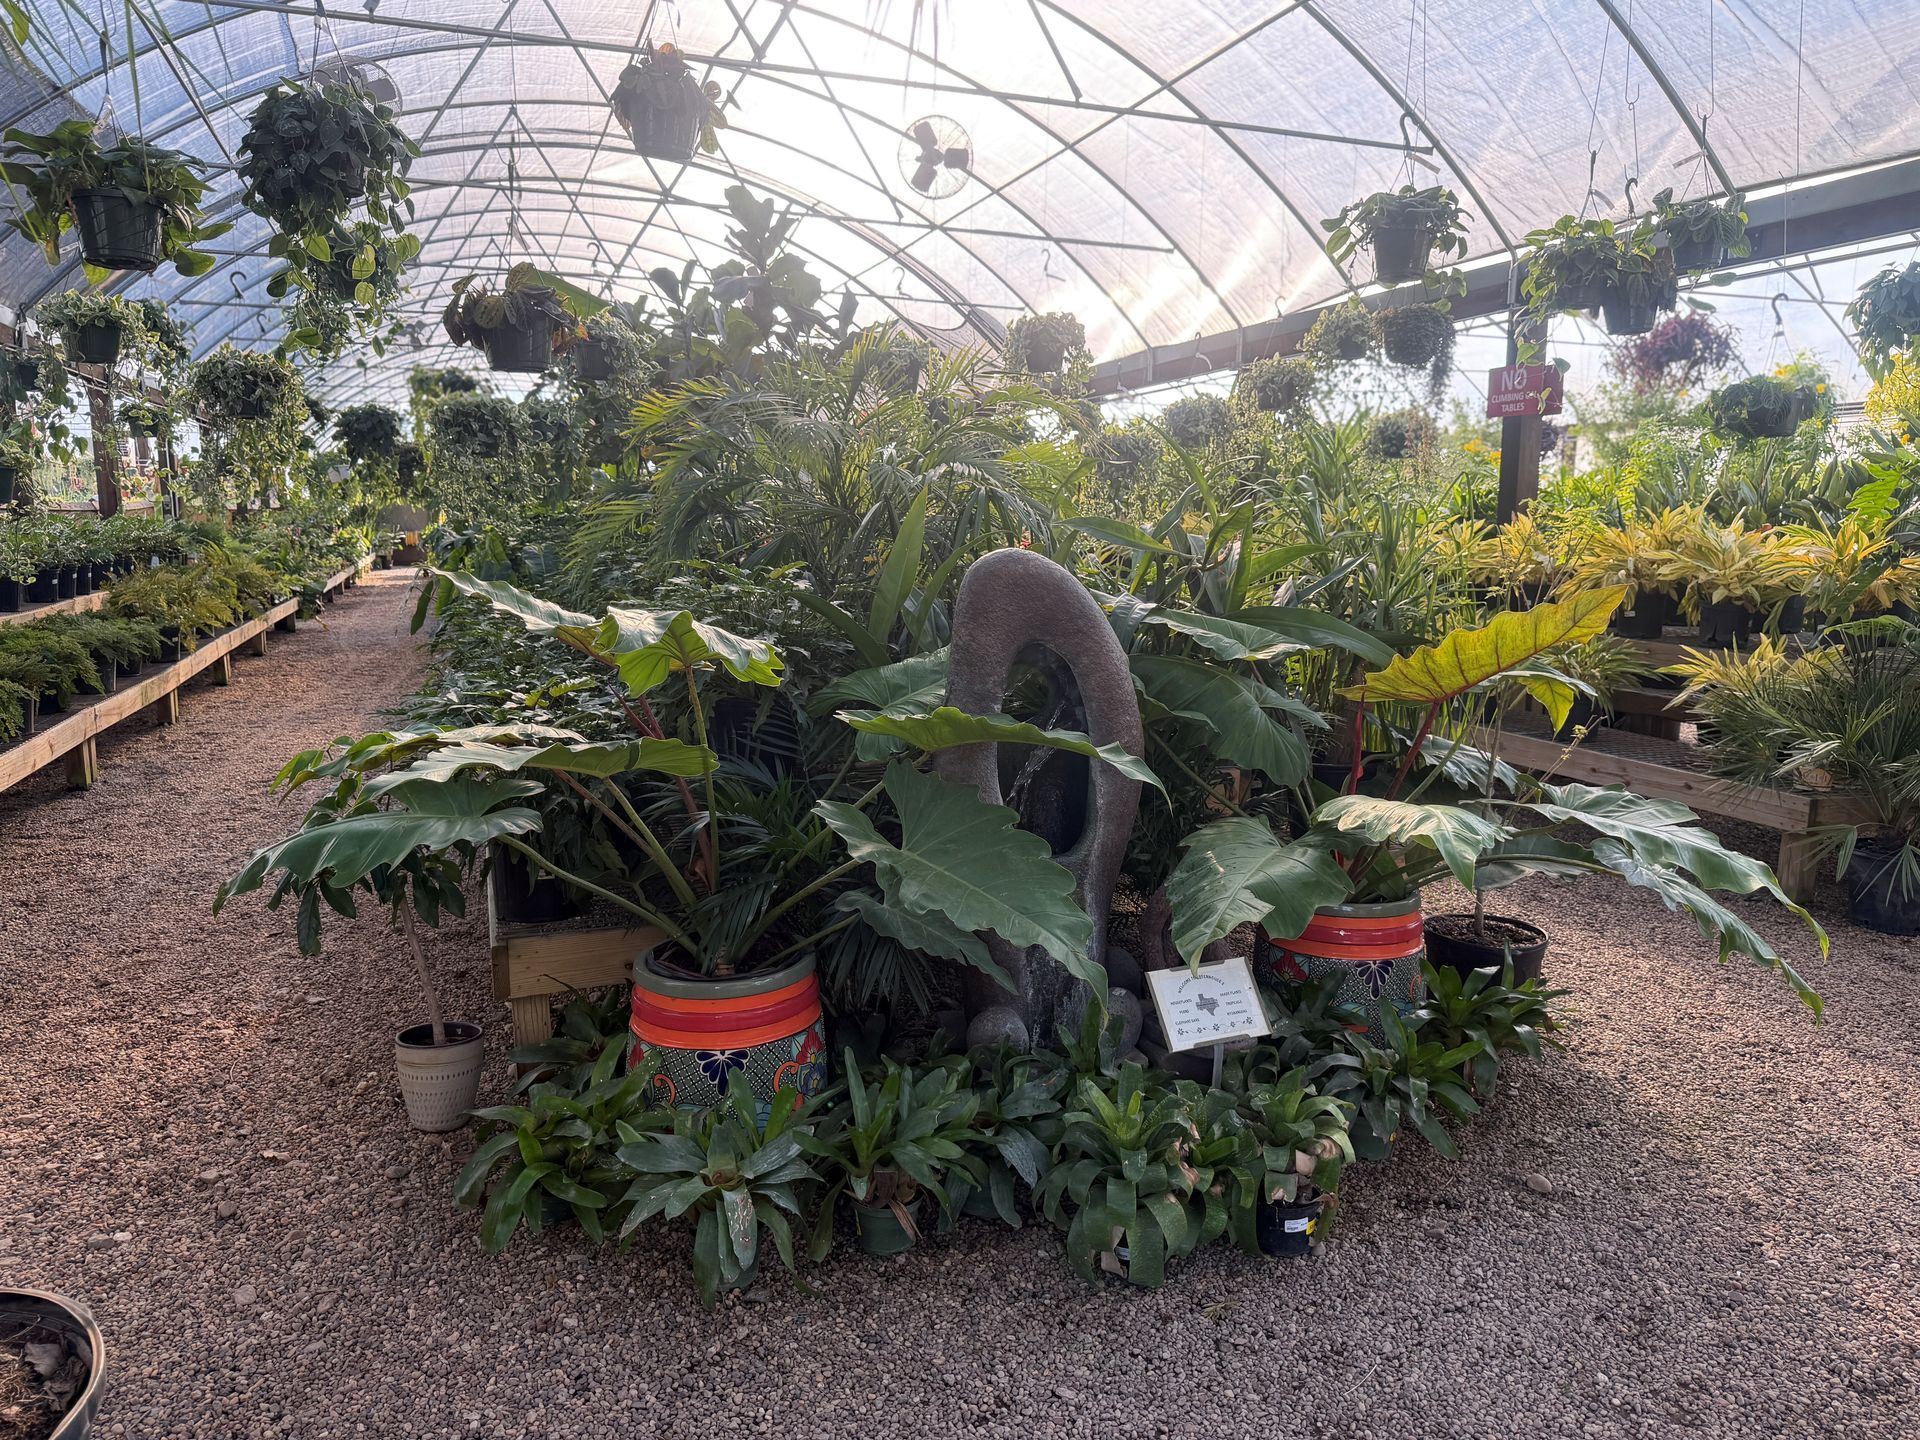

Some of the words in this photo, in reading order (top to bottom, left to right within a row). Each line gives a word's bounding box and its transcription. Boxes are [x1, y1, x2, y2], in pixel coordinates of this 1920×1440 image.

[1502, 368, 1527, 391] NO
[1491, 392, 1525, 403] CLIMBING
[1501, 402, 1525, 413] TABLES
[1178, 977, 1192, 994] WELCOME
